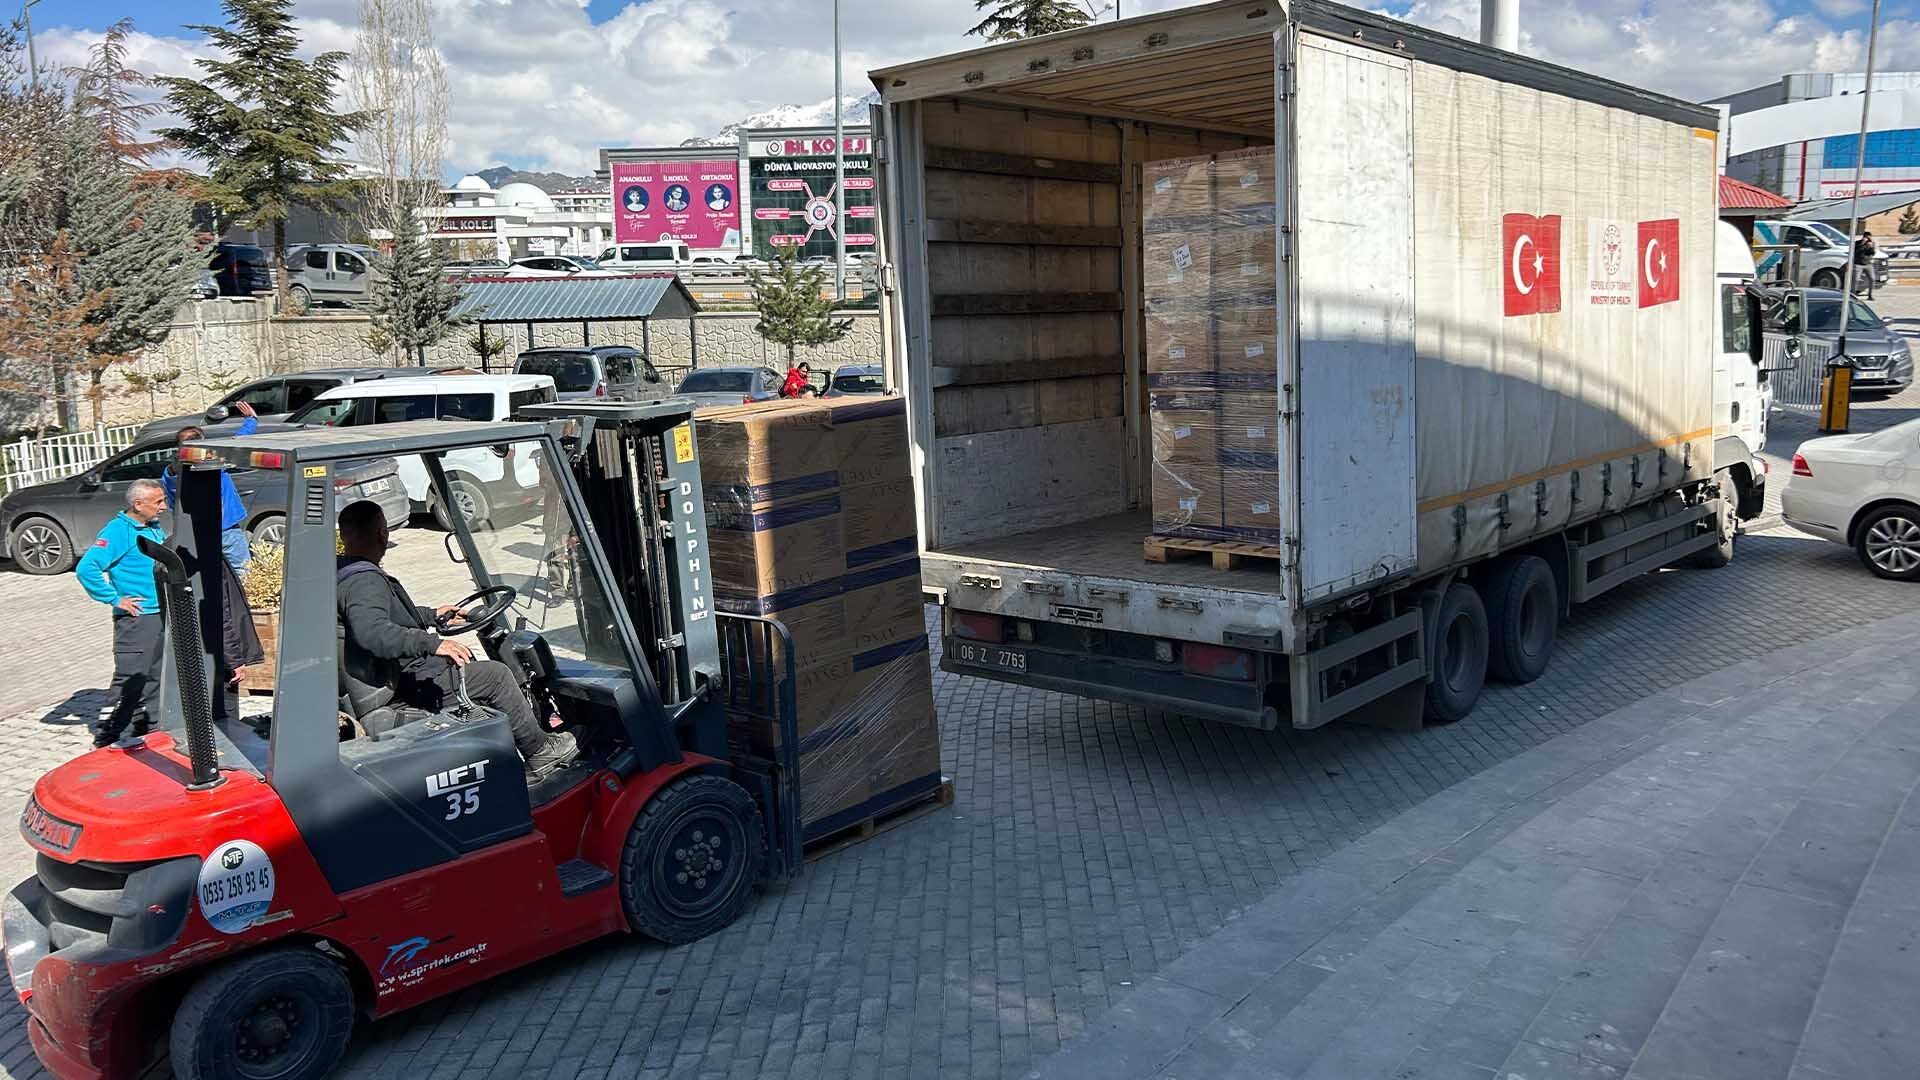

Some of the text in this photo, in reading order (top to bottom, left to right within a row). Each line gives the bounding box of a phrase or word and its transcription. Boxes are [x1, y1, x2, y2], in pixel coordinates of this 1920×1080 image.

[619, 175, 653, 183] ANAOKULU
[700, 173, 734, 181] ORTAOKUL
[764, 162, 793, 172] DÜNYA
[680, 481, 705, 611] DOLPHIN
[961, 644, 1025, 669] 06 Z 2763
[425, 759, 490, 798] LIFT
[445, 786, 480, 821] 35
[223, 850, 243, 867] MTF
[202, 866, 270, 906] 0535 258 93 45
